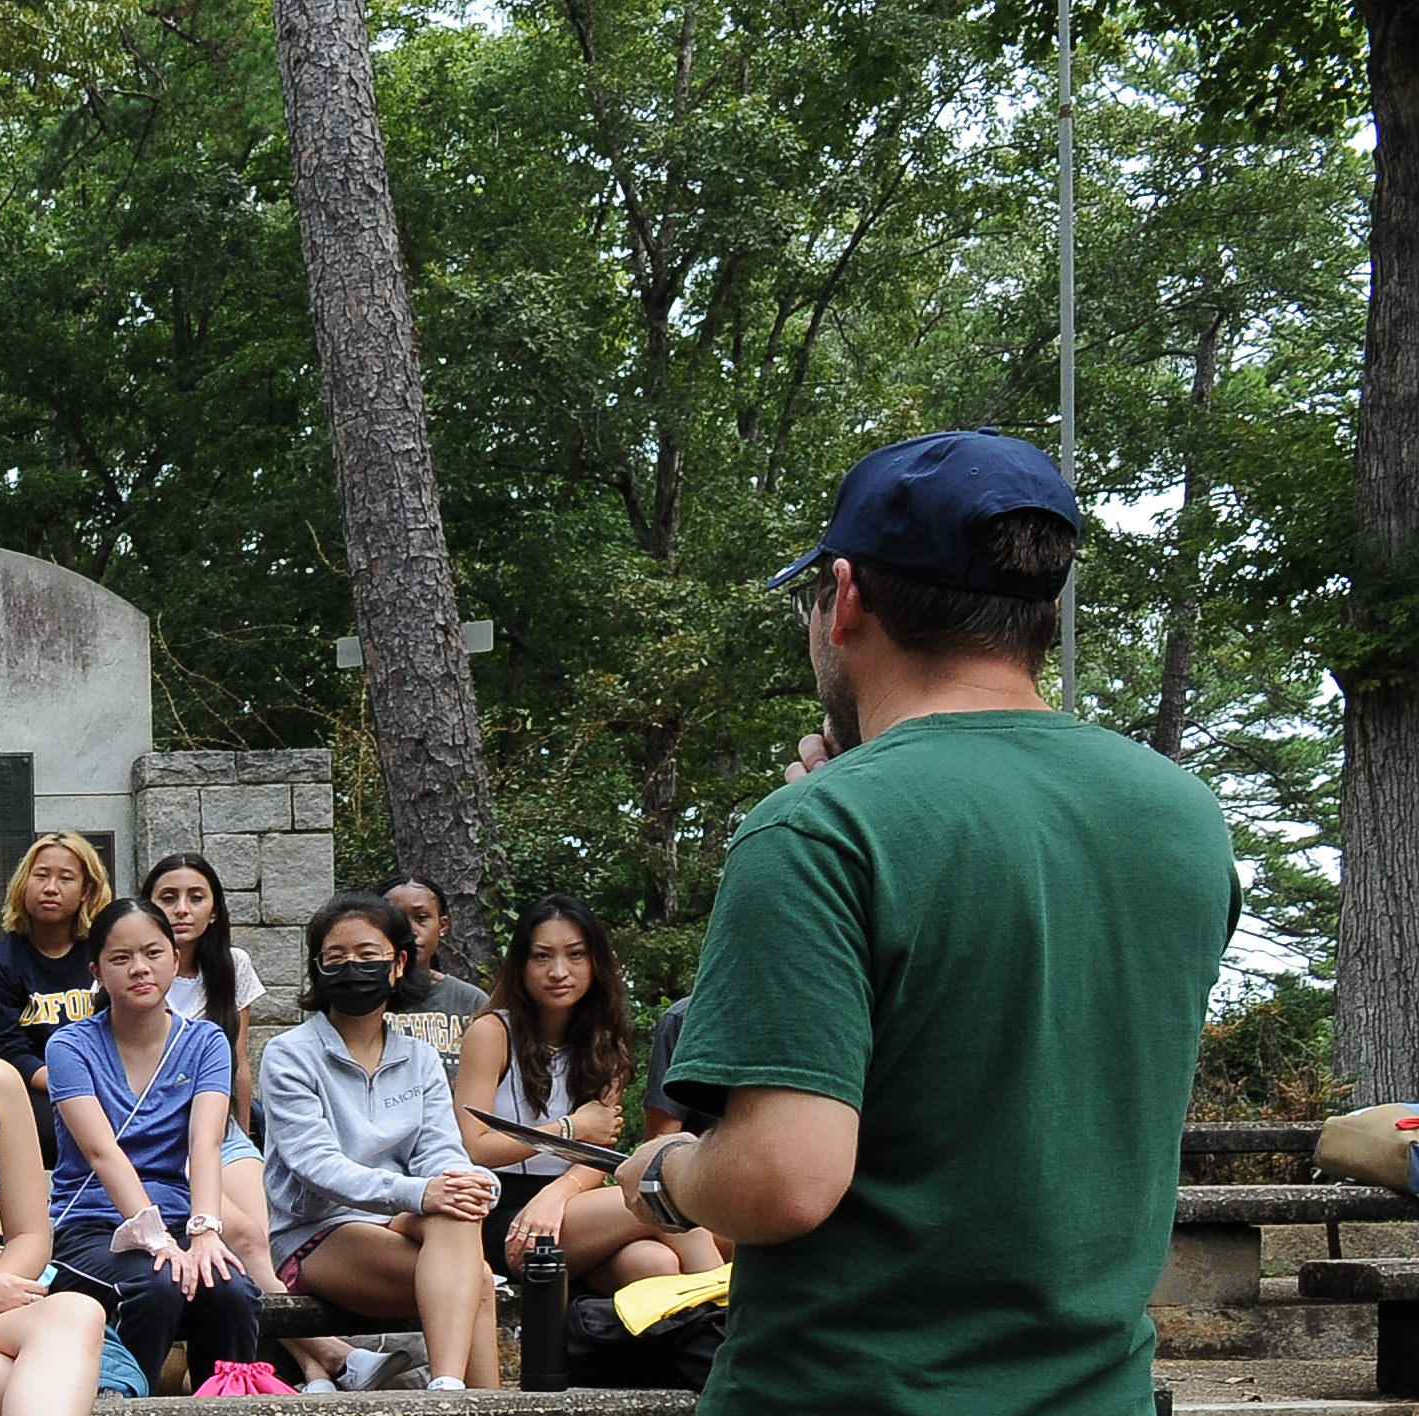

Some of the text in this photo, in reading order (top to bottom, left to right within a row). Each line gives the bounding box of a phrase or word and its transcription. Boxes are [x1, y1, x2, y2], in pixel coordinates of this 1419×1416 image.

[19, 989, 95, 1027] OXFO
[383, 1012, 470, 1055] CHIGA
[384, 1085, 424, 1109] EMOR
